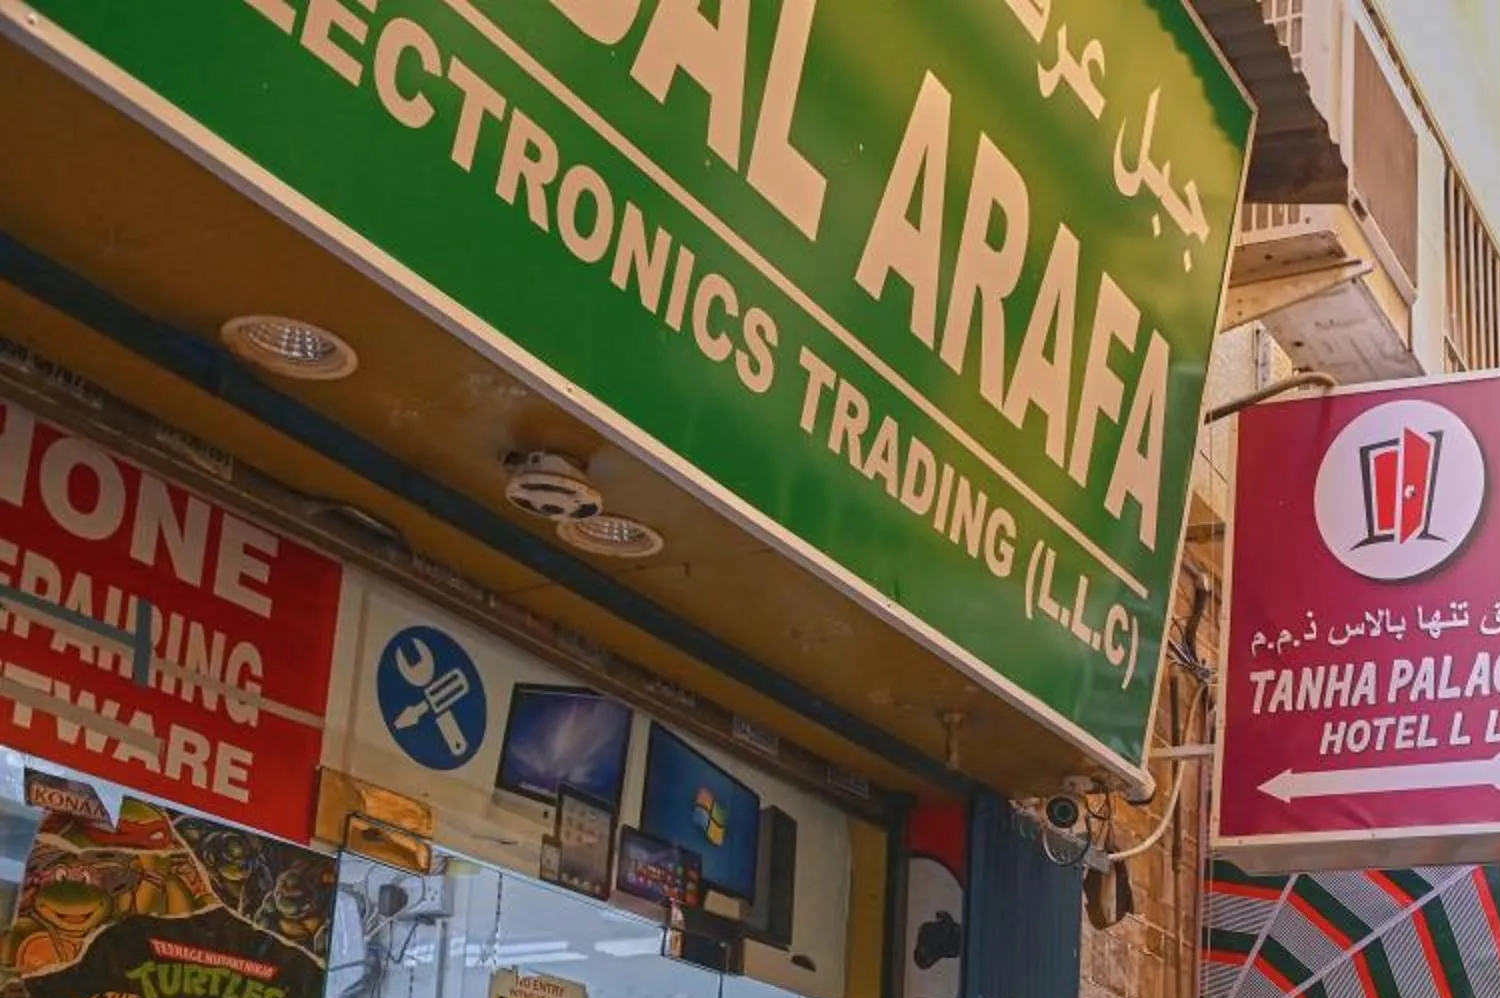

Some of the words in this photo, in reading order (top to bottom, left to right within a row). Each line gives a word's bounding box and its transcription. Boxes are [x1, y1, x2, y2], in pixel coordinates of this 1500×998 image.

[1114, 86, 1210, 272] جبل
[855, 70, 1170, 551] ARAFA
[799, 346, 1016, 578] TRADING
[1328, 610, 1407, 646] بالاس
[1416, 602, 1470, 640] تنها
[0, 660, 254, 804] TWARE
[1249, 661, 1378, 716] TANHA
[1319, 714, 1439, 756] HOTEL
[1449, 712, 1471, 746] L
